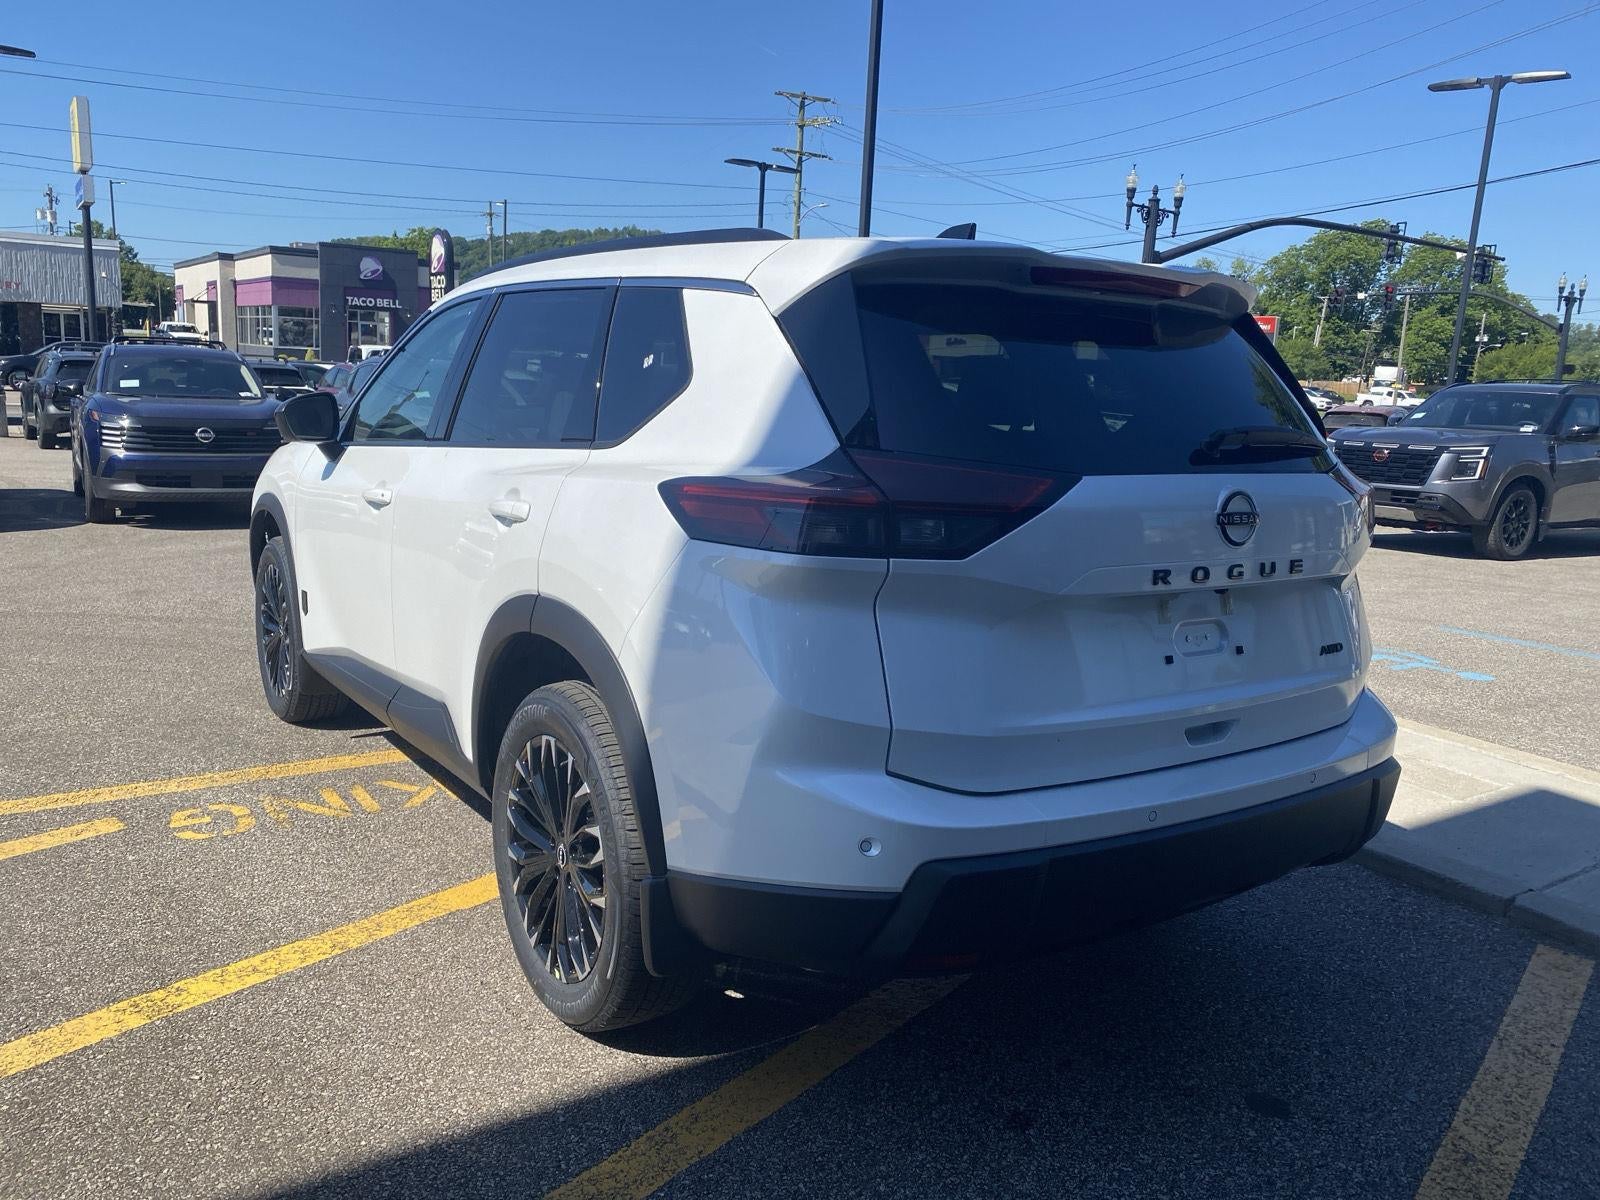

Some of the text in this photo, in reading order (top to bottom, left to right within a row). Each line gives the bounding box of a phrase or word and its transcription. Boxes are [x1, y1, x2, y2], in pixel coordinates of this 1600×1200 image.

[430, 275, 445, 288] TACO
[346, 296, 402, 309] TACO BELL
[1151, 558, 1304, 586] ROGUE
